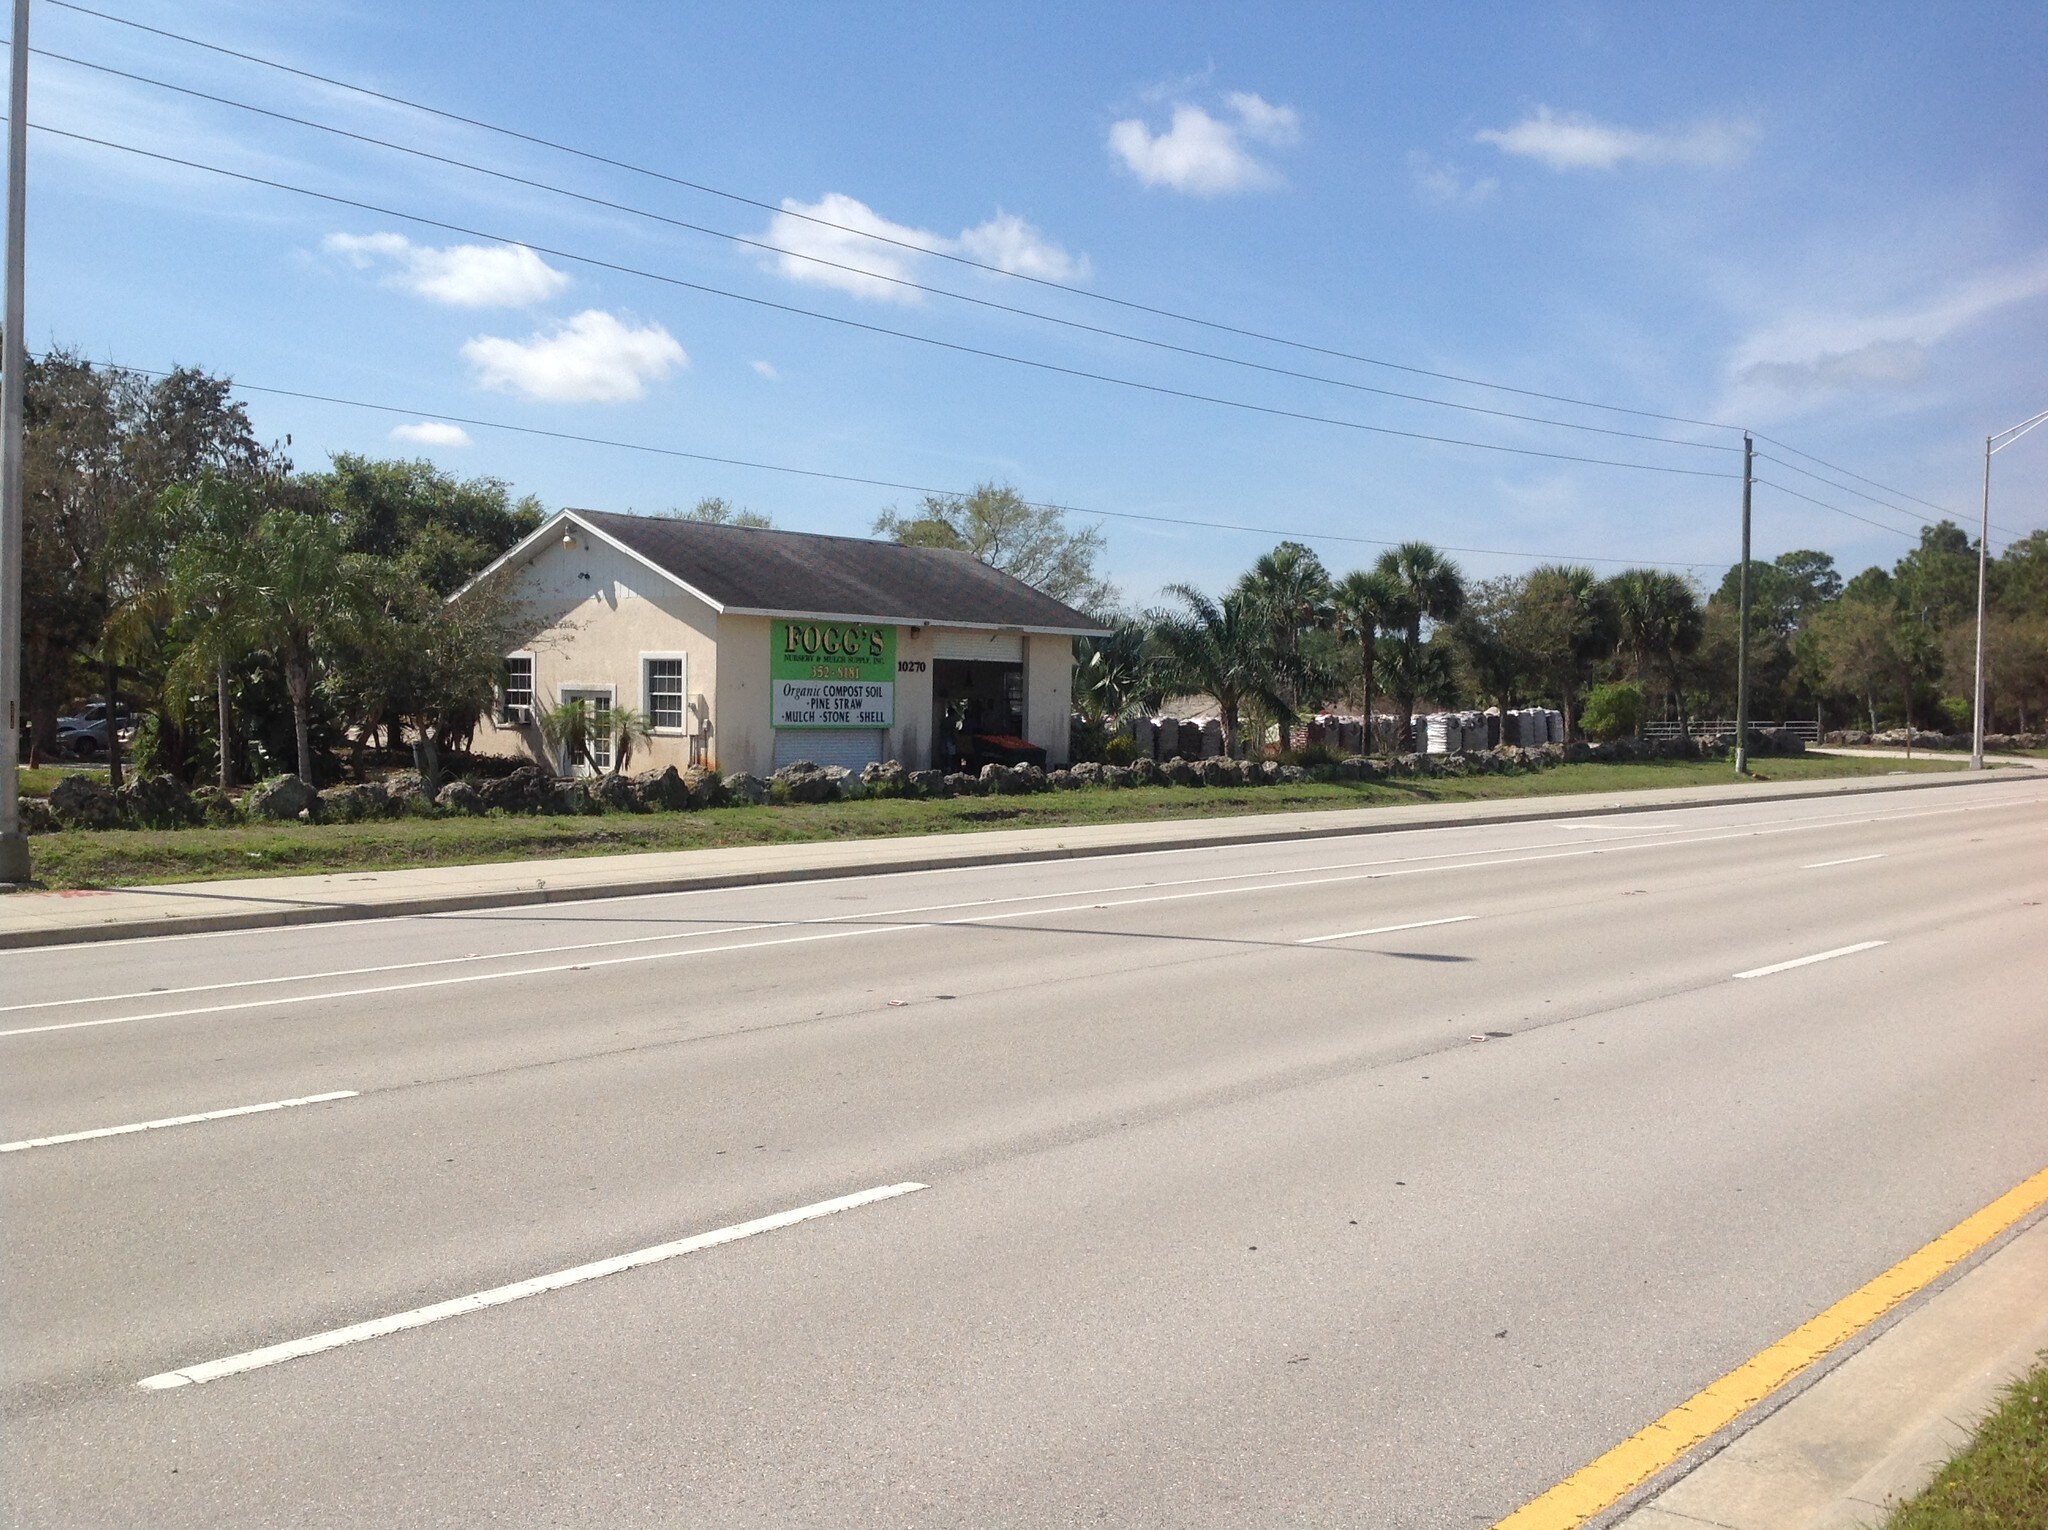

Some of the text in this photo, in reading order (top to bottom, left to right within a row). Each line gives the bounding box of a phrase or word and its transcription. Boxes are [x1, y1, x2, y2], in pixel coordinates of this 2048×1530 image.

[785, 624, 885, 656] FOGG'S
[898, 661, 926, 673] 10270
[783, 683, 883, 700] Organic COMPOST SOIL
[834, 698, 863, 710] STRAW
